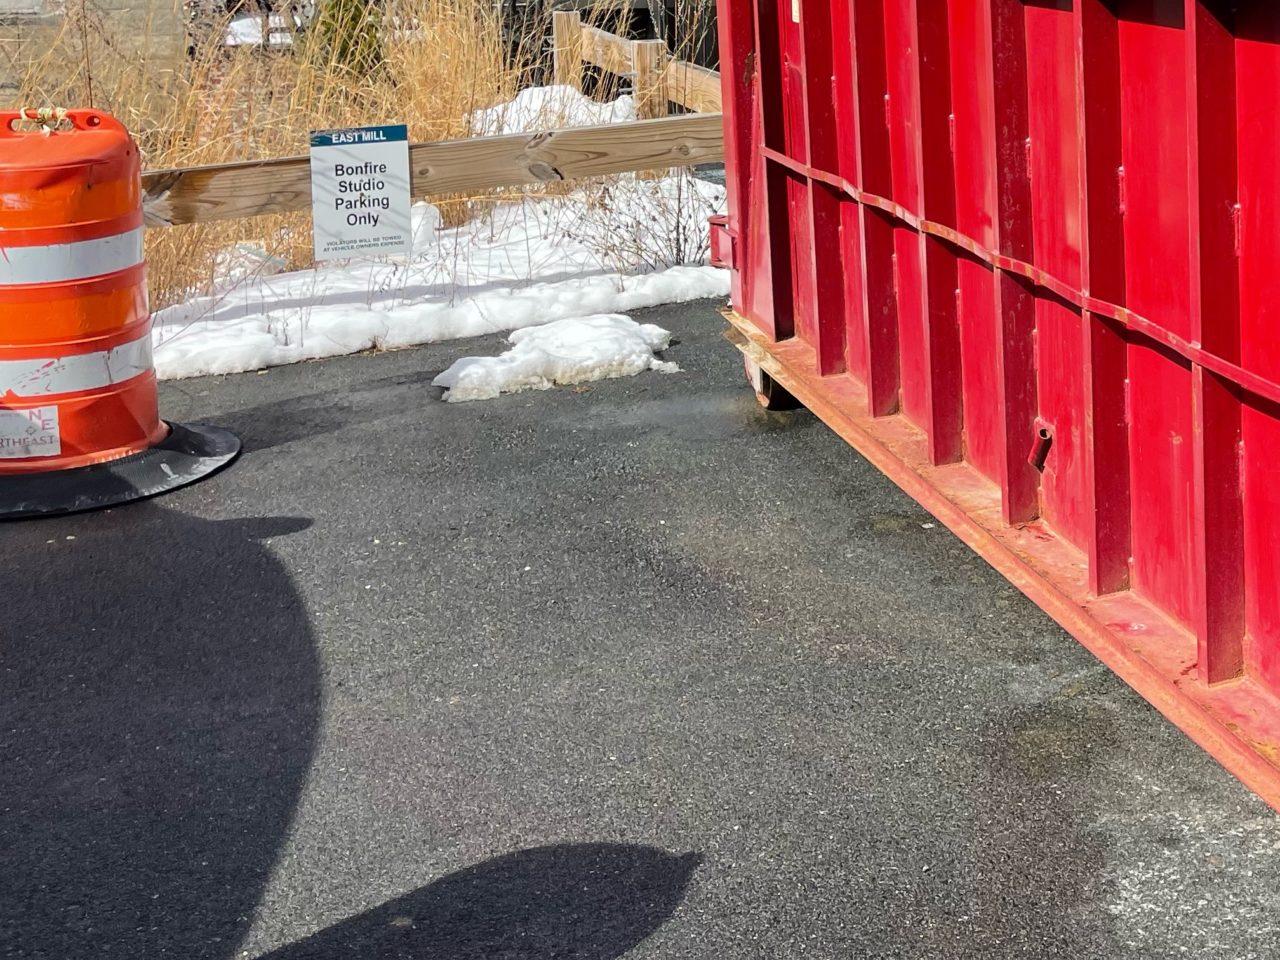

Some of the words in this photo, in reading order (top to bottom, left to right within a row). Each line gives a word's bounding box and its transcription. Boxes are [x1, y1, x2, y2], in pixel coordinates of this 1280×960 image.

[332, 132, 359, 144] EAST
[362, 130, 387, 142] MILL
[335, 161, 387, 177] Bonfire
[338, 178, 385, 193] Studio
[335, 196, 390, 211] Parking
[346, 212, 380, 227] Only
[326, 239, 358, 247] VIOLATORS
[356, 242, 380, 250] OWNERS
